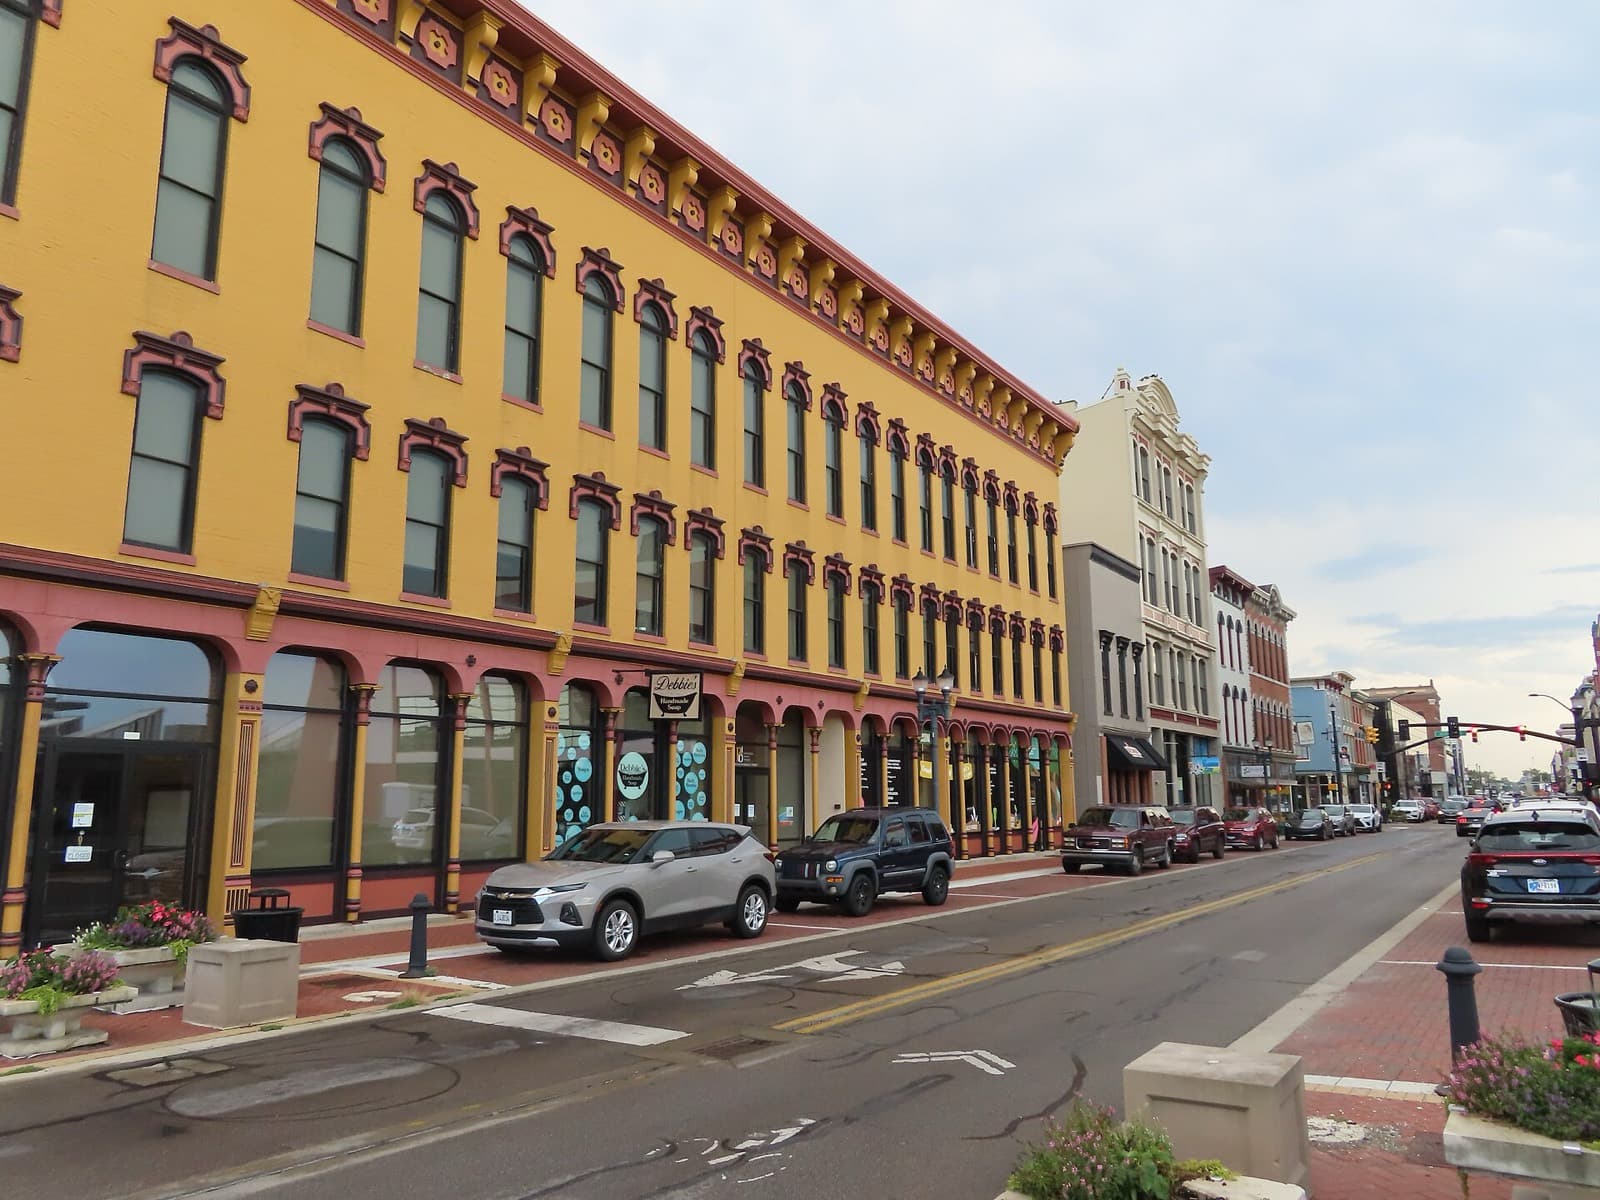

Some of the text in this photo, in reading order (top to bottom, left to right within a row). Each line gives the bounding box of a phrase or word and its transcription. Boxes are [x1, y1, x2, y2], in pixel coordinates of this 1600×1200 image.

[655, 675, 697, 691] Debbie's
[660, 697, 689, 705] Handmade
[620, 763, 646, 771] Debbie's
